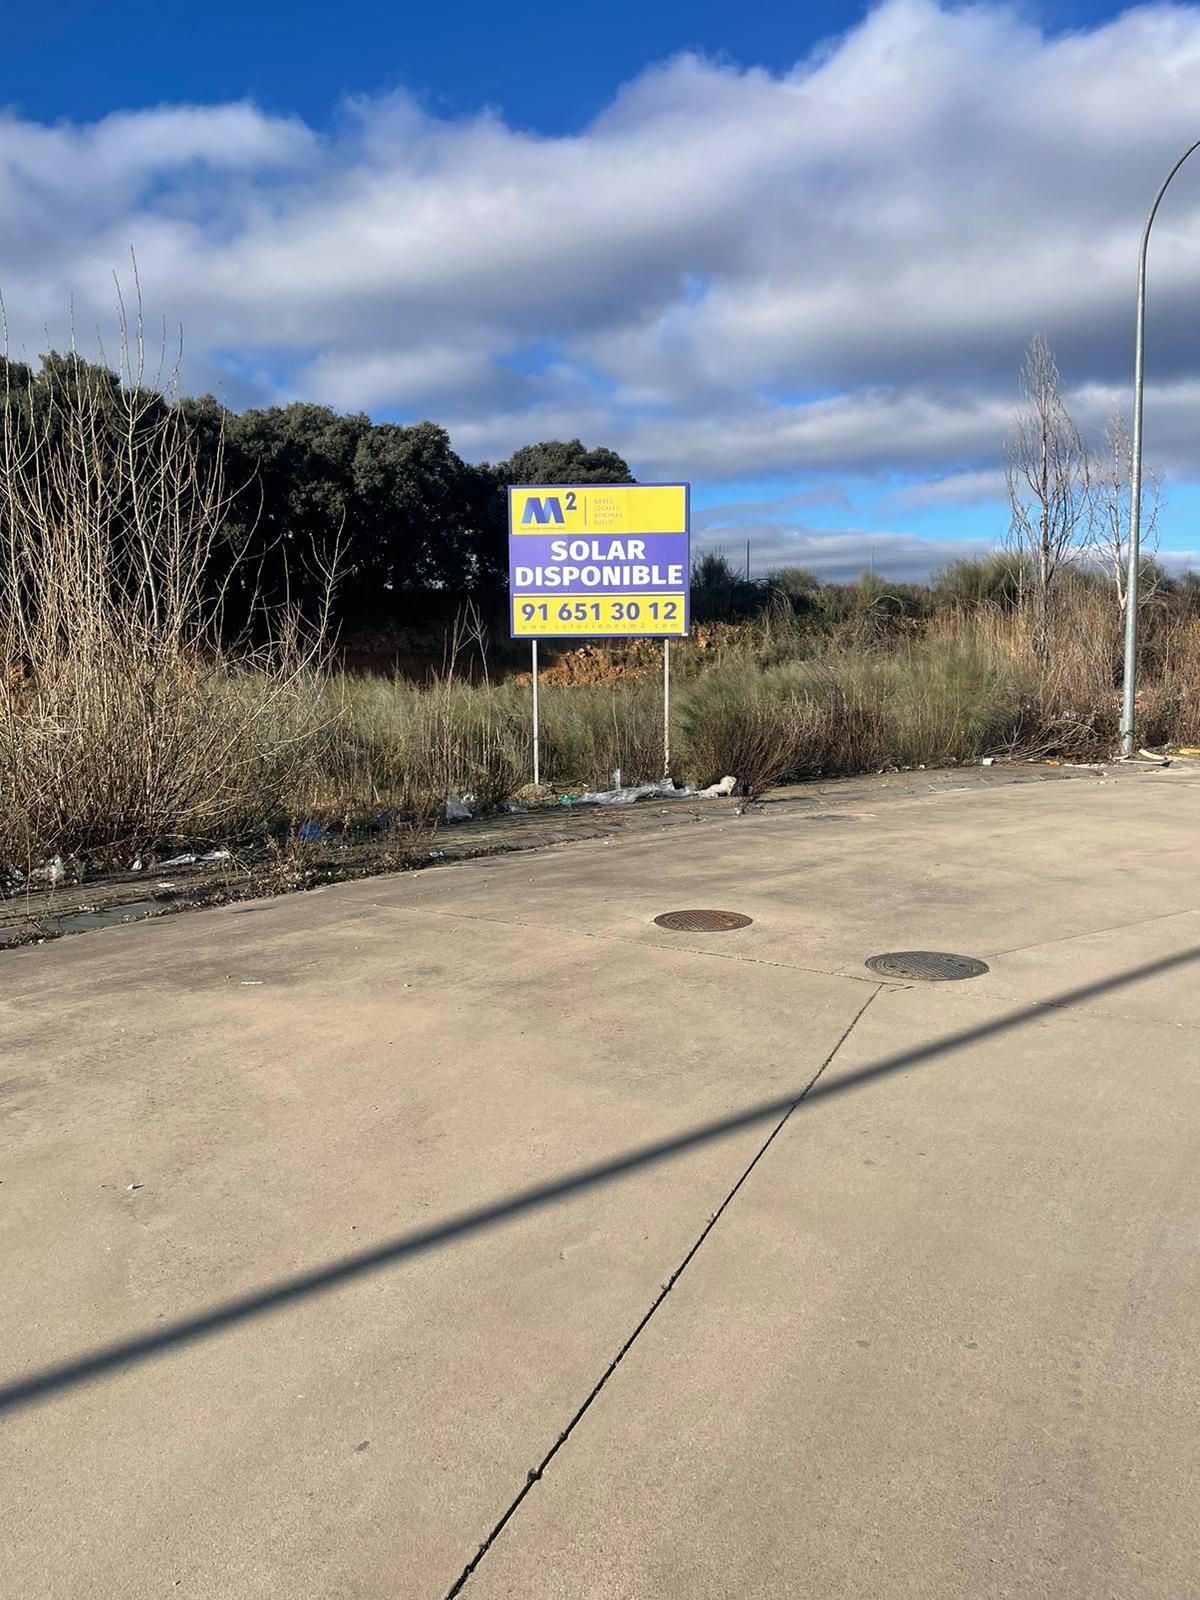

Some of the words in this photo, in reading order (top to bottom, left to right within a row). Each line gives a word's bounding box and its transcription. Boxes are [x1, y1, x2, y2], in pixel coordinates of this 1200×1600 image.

[550, 540, 646, 561] SOLAR
[515, 565, 683, 587] DISPONIBLE
[521, 603, 547, 621] 91
[558, 603, 600, 621] 651
[611, 602, 640, 620] 30
[648, 601, 677, 620] 12
